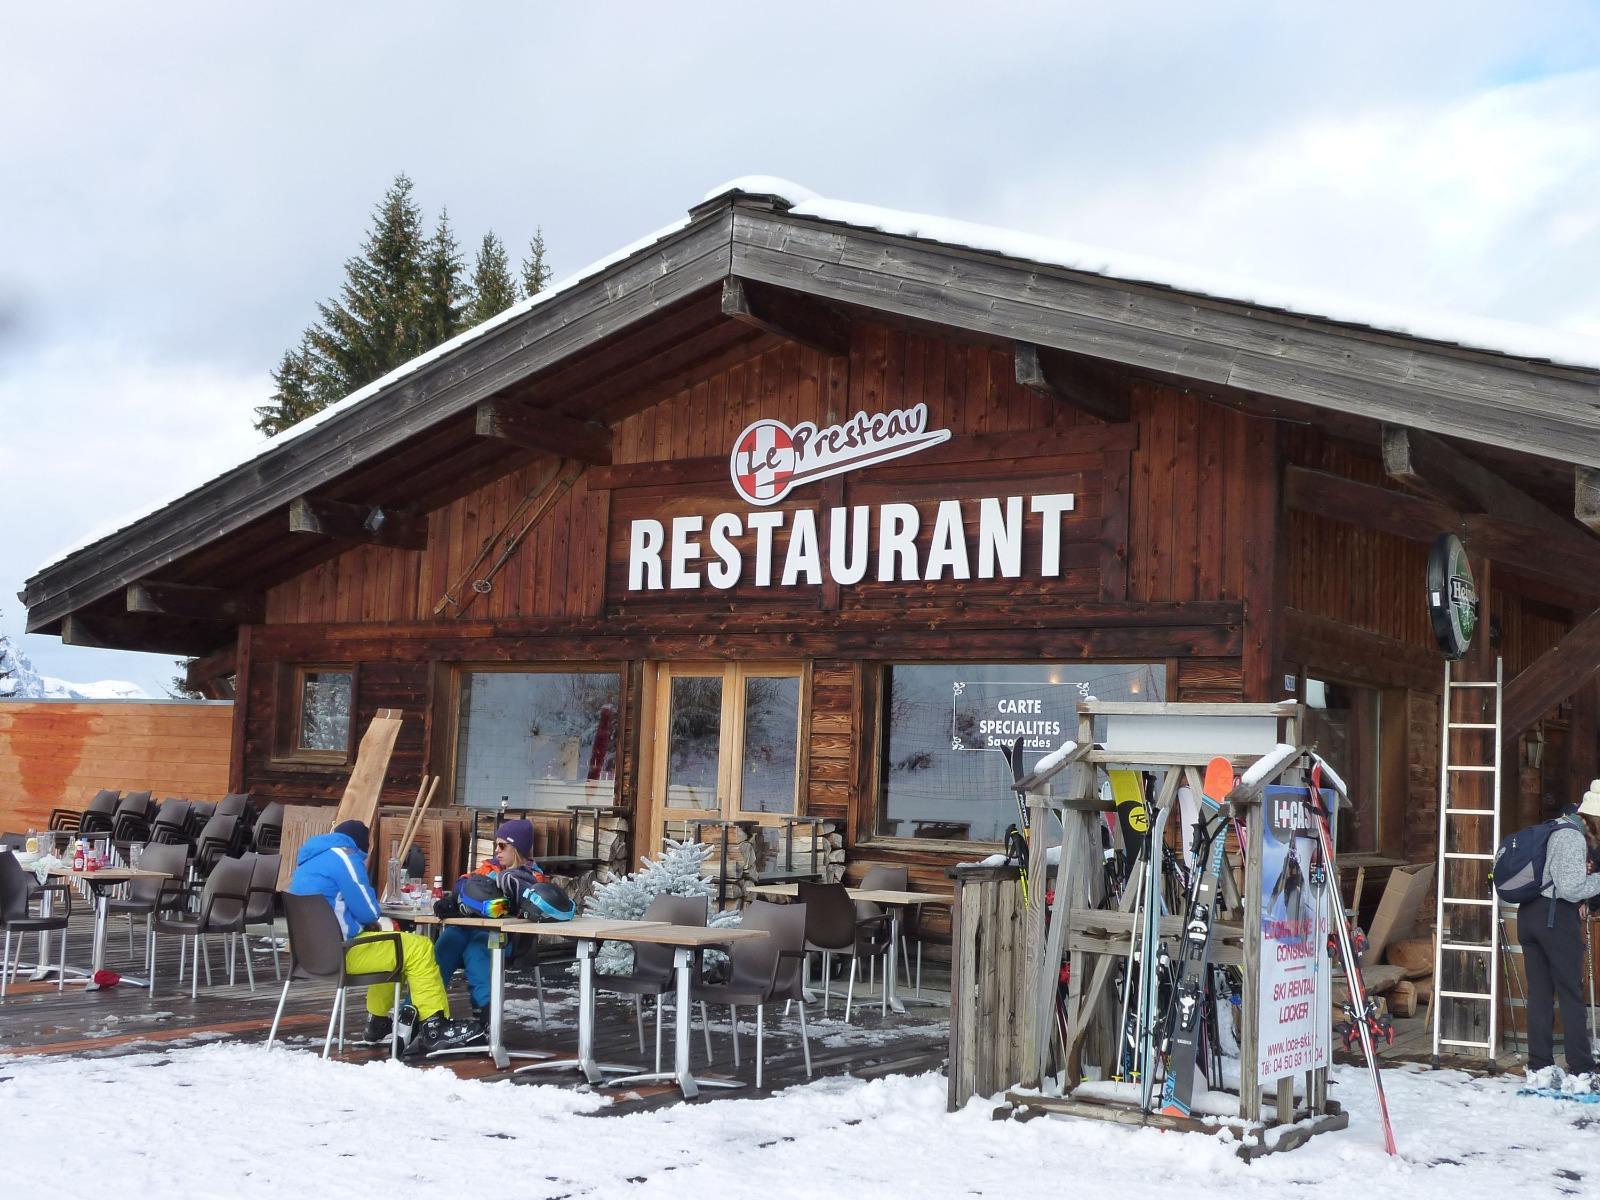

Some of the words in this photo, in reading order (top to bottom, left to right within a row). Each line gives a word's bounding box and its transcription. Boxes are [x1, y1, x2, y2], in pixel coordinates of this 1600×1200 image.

[746, 443, 782, 474] Le
[794, 407, 924, 461] Presteau
[628, 493, 1075, 591] RESTAURANT
[997, 699, 1042, 714] CARTE
[979, 720, 1061, 736] SPECIALITES
[987, 735, 1051, 748] Savordes
[1273, 981, 1287, 1001] SKI
[1287, 978, 1315, 998] RENTAL
[1279, 1002, 1309, 1024] LOCKER
[1284, 1054, 1294, 1069] 50
